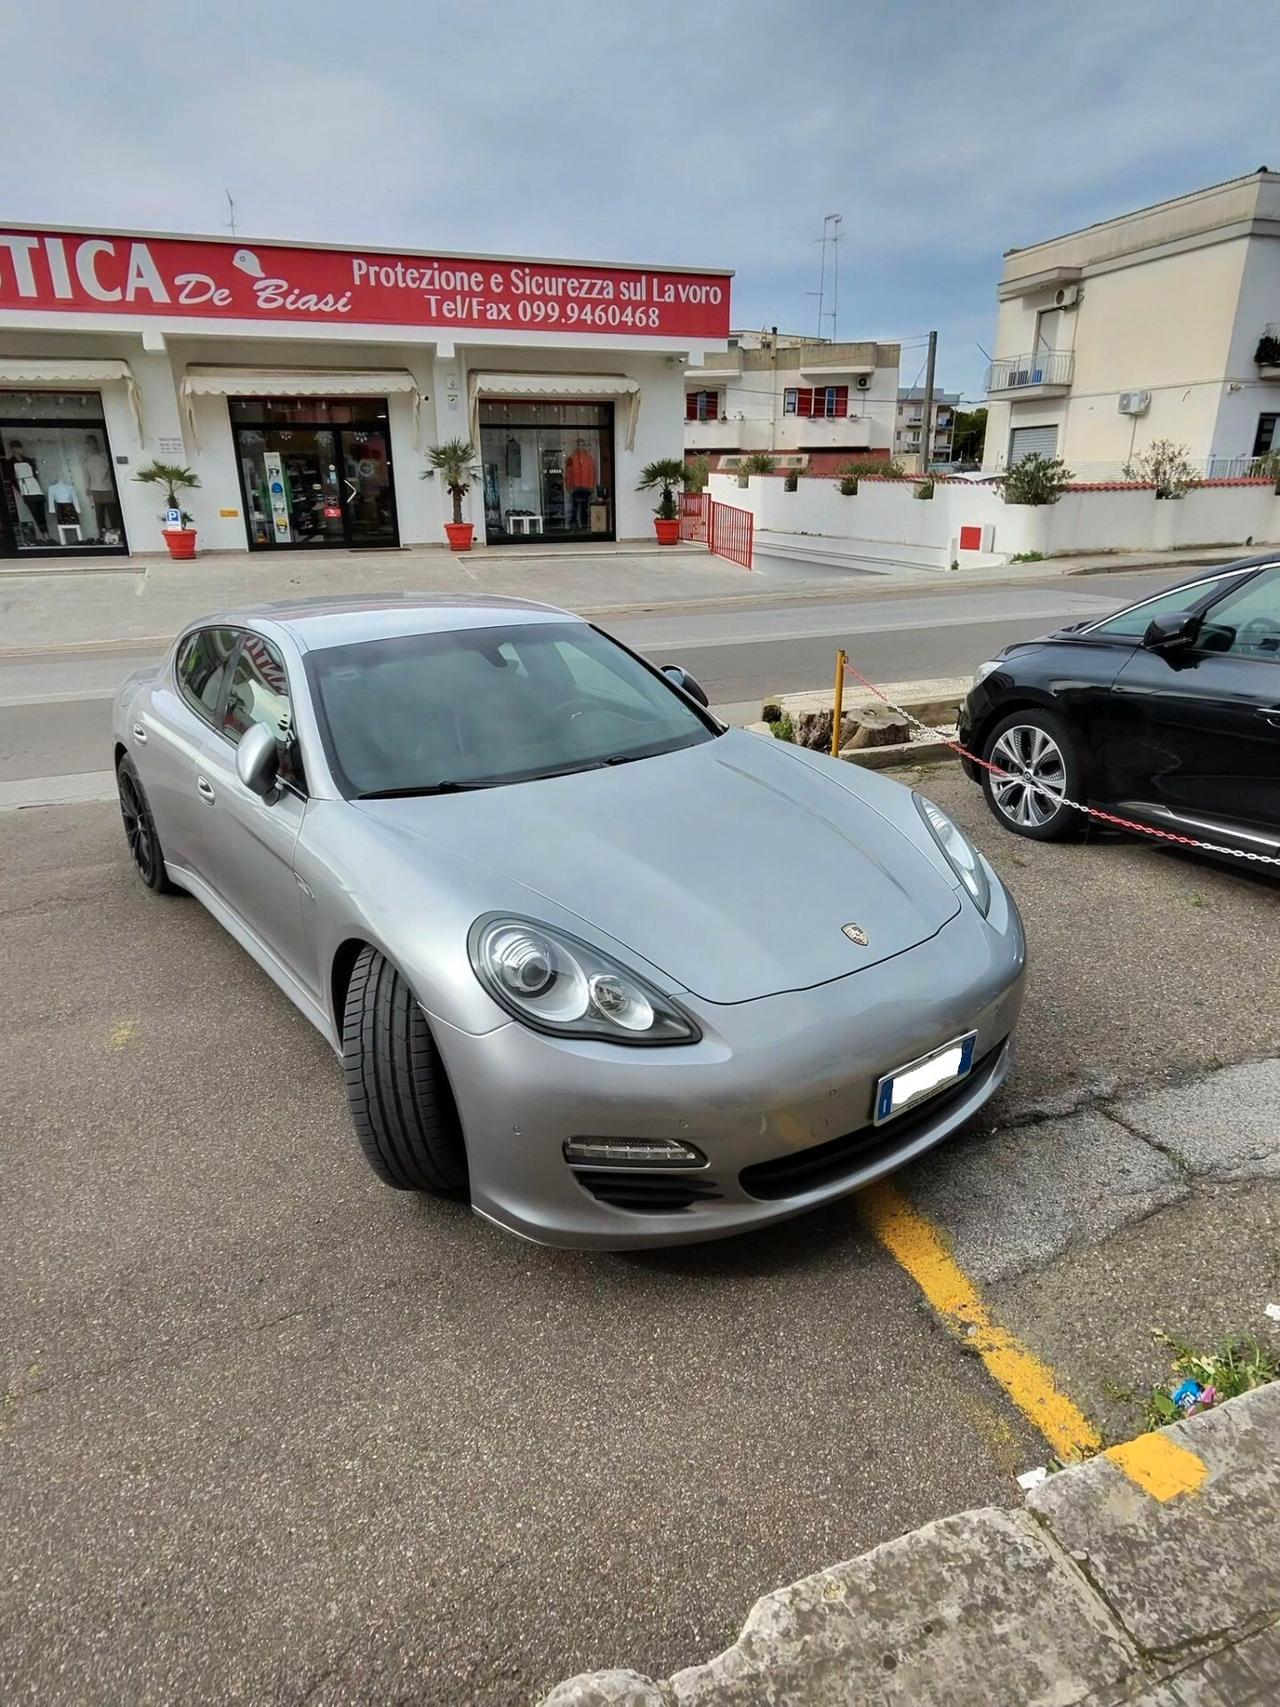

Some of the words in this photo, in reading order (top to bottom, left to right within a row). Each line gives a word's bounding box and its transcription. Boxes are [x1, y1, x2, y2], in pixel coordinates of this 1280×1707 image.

[0, 235, 172, 304] TICA
[352, 258, 484, 293] Protezione
[490, 273, 503, 293] e
[510, 268, 614, 300] Sicurezza
[619, 275, 646, 301] sul
[174, 273, 233, 307] De
[253, 278, 353, 313] Biasi
[424, 294, 513, 321] Tel/Fax
[518, 300, 660, 328] 099.9460468
[168, 511, 177, 521] P
